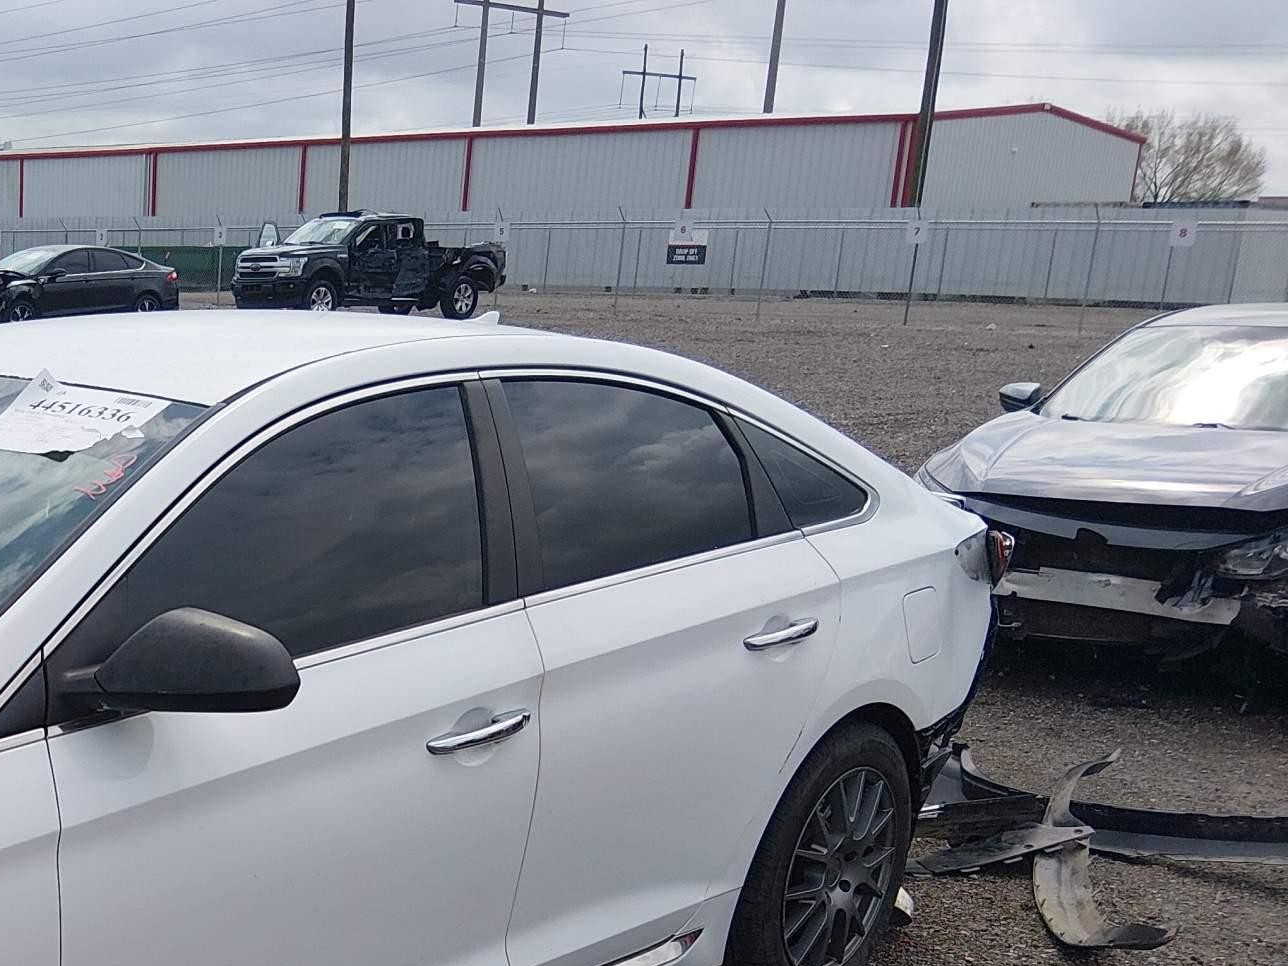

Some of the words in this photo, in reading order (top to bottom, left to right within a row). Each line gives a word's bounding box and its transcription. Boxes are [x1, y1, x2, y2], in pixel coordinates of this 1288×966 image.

[499, 227, 504, 235] 5
[913, 227, 921, 237] 7
[1178, 228, 1188, 238] 8
[28, 398, 136, 423] 44516336
